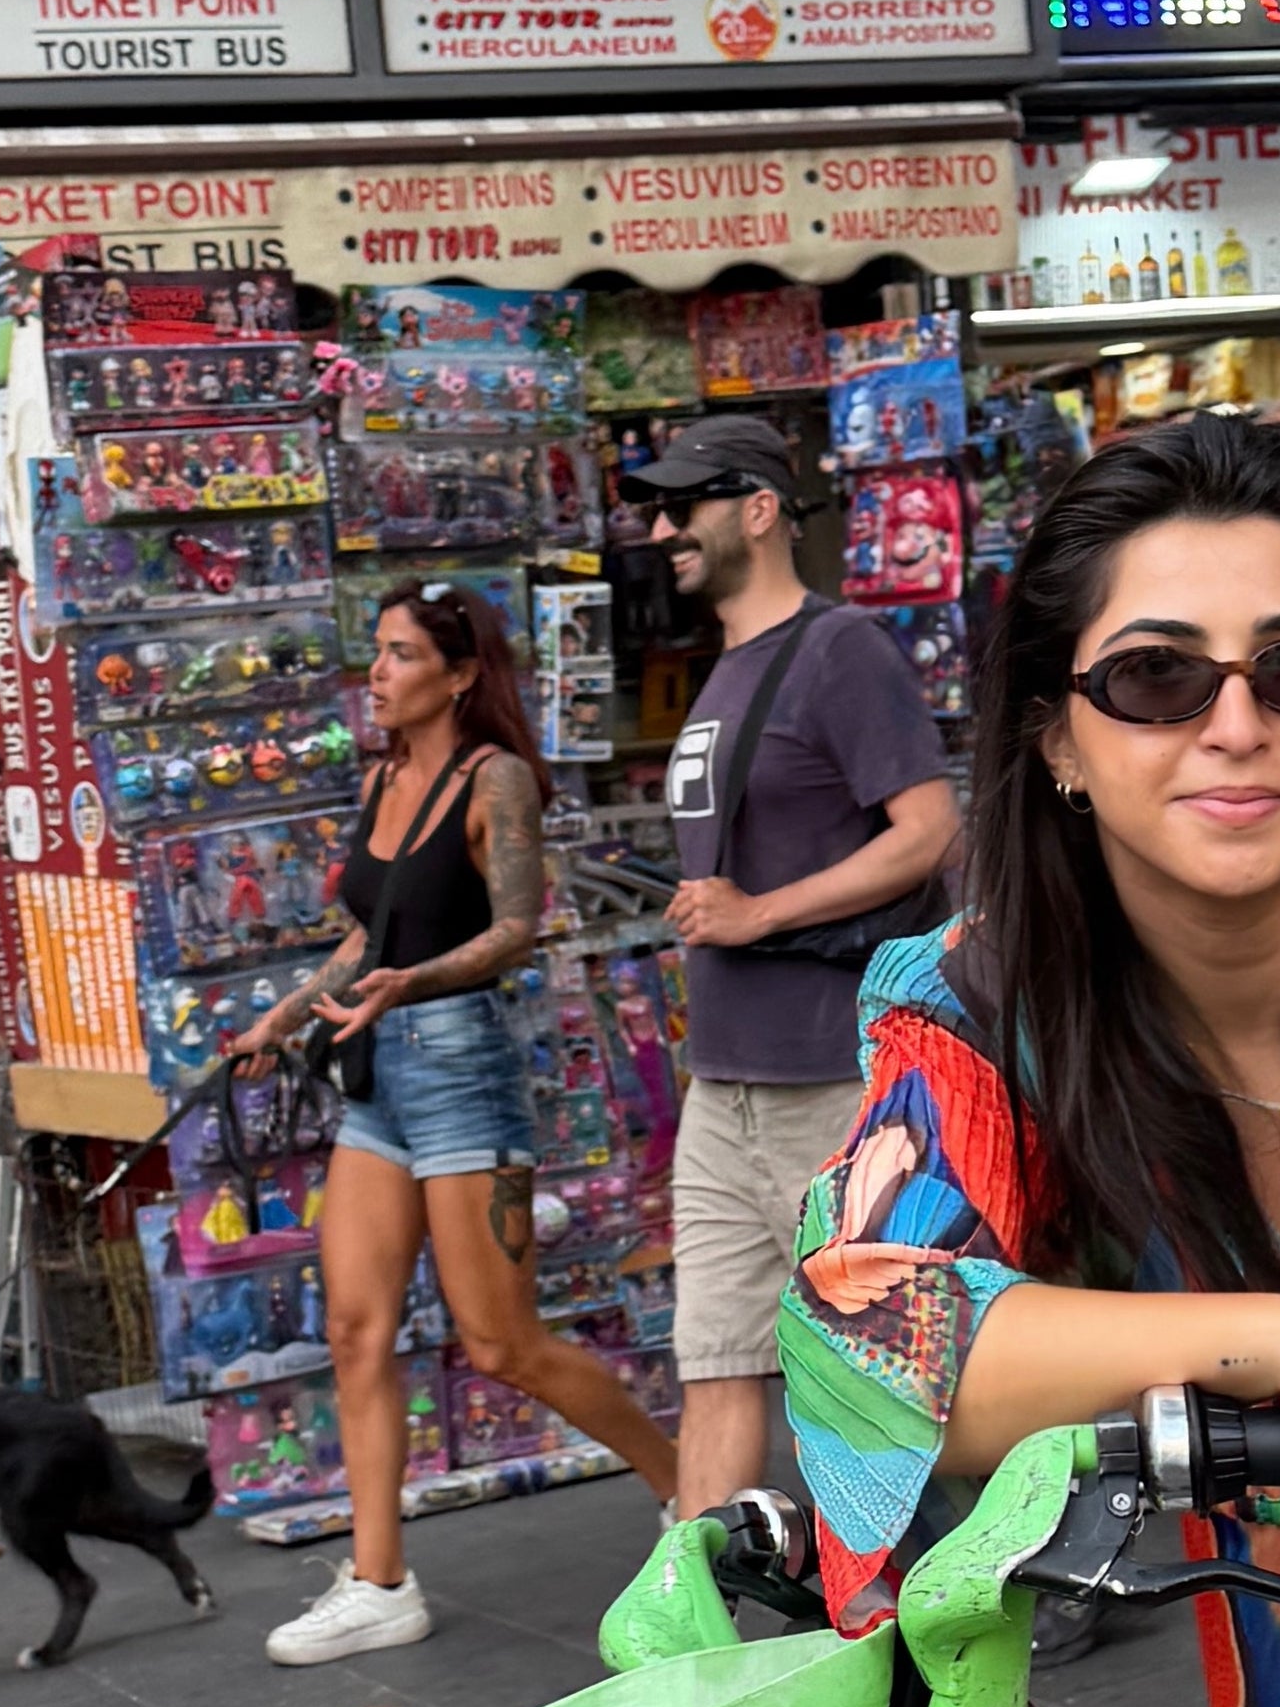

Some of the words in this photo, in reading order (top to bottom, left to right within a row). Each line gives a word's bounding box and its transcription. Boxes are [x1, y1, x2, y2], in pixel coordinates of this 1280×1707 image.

[434, 9, 507, 31] CITY
[516, 9, 601, 30] TOUR
[802, 22, 996, 46] AMALFI-POSITANO
[37, 38, 194, 71] TOURIST
[217, 36, 288, 69] BUS
[437, 36, 678, 59] HERCULANEUM
[357, 178, 468, 213] POMPEII
[473, 173, 556, 209] RUINS
[605, 161, 785, 204] VESUVIUS
[823, 154, 998, 192] SORRENTO
[134, 179, 276, 220] POINT
[193, 238, 288, 270] BUS
[363, 228, 419, 264] CITY
[426, 224, 500, 261] TOUR
[613, 212, 790, 256] HERCULANEUM
[2, 721, 25, 771] BUS
[33, 675, 65, 853] VESUVIUS
